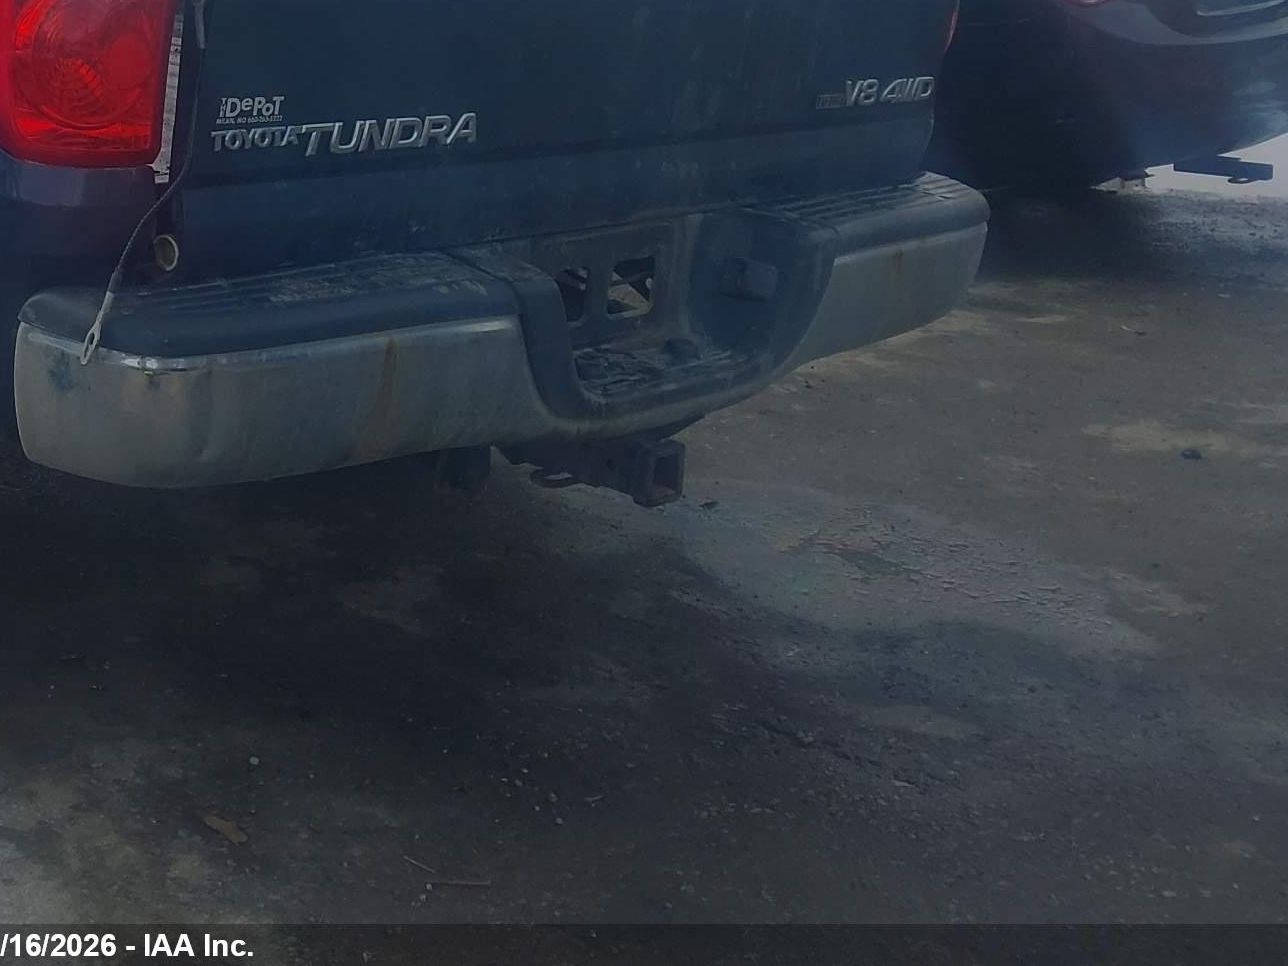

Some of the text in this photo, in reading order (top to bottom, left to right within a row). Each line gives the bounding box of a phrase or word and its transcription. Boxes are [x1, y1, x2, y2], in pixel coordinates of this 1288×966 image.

[846, 79, 879, 106] V8
[211, 112, 477, 156] TOYOTA TUNDRA
